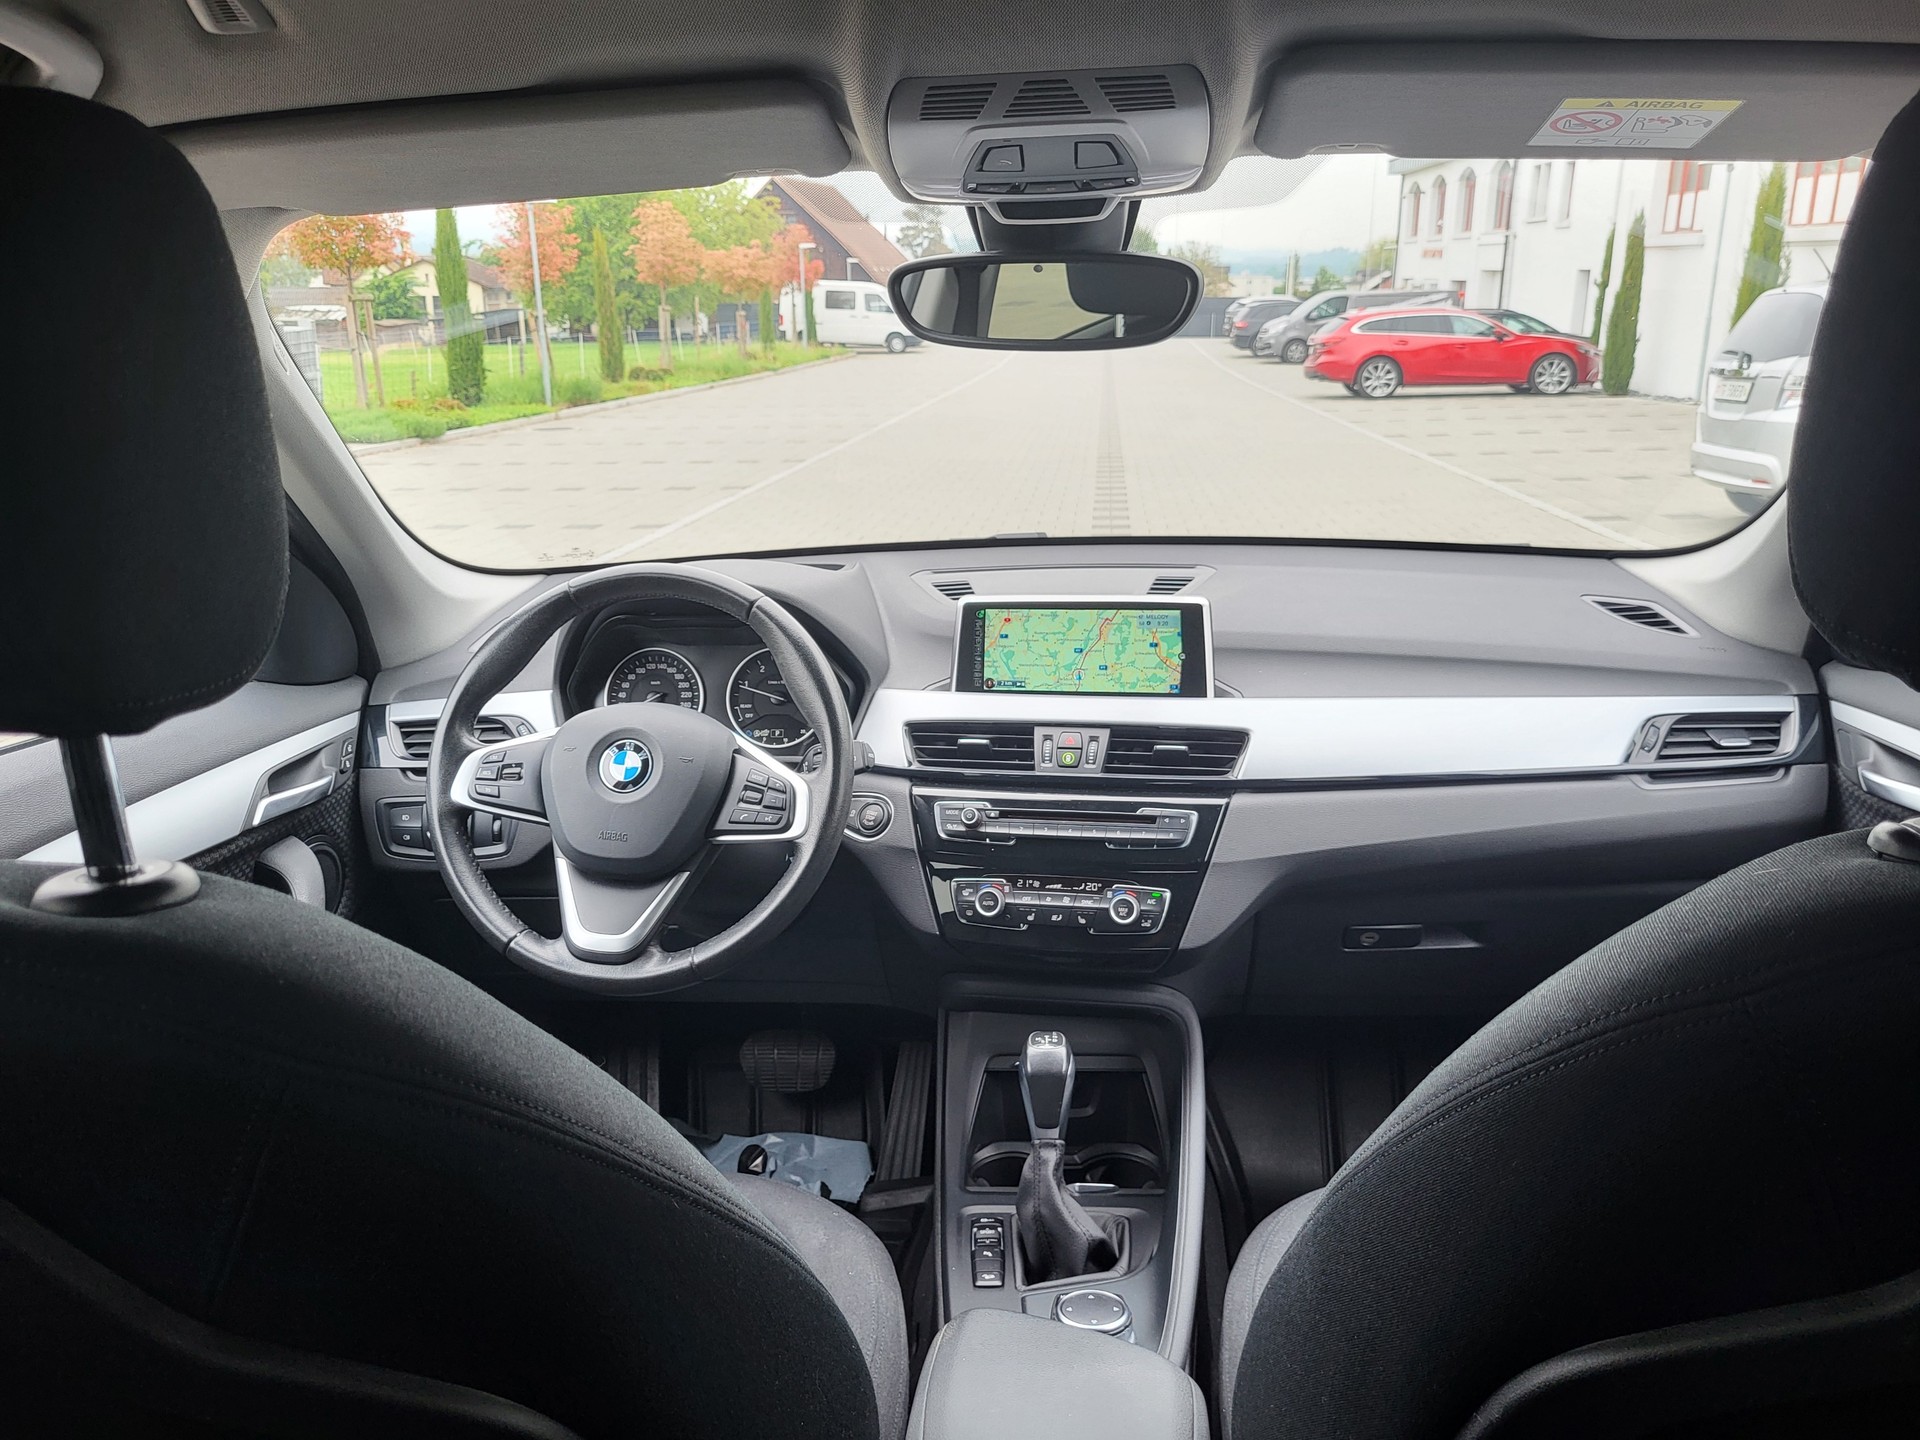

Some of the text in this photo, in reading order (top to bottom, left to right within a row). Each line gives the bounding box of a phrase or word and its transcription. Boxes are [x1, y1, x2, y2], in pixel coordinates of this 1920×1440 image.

[1624, 100, 1704, 109] AIRBAG
[760, 665, 765, 673] 2
[608, 742, 648, 761] BMW
[598, 830, 628, 842] AIRBAG
